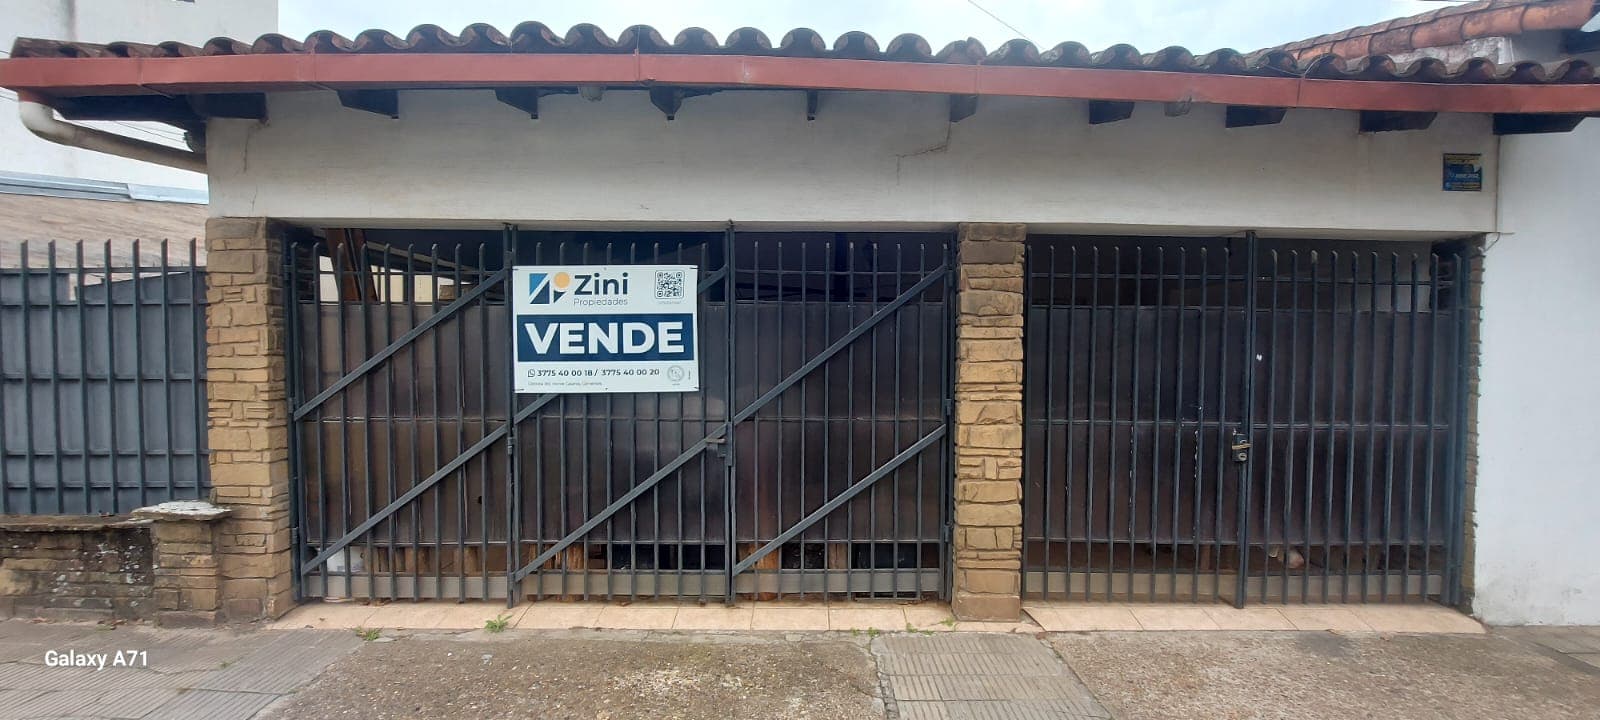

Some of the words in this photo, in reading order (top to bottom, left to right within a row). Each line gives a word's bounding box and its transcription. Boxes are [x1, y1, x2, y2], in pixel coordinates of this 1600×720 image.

[574, 272, 628, 295] Zini
[574, 297, 628, 307] Propiedades
[524, 321, 685, 355] VENDE
[537, 369, 556, 377] 3775
[558, 369, 568, 377] 40
[571, 369, 582, 377] 00
[601, 368, 621, 376] 3775
[623, 368, 634, 376] 40
[636, 368, 647, 376] 00
[649, 368, 660, 376] 20
